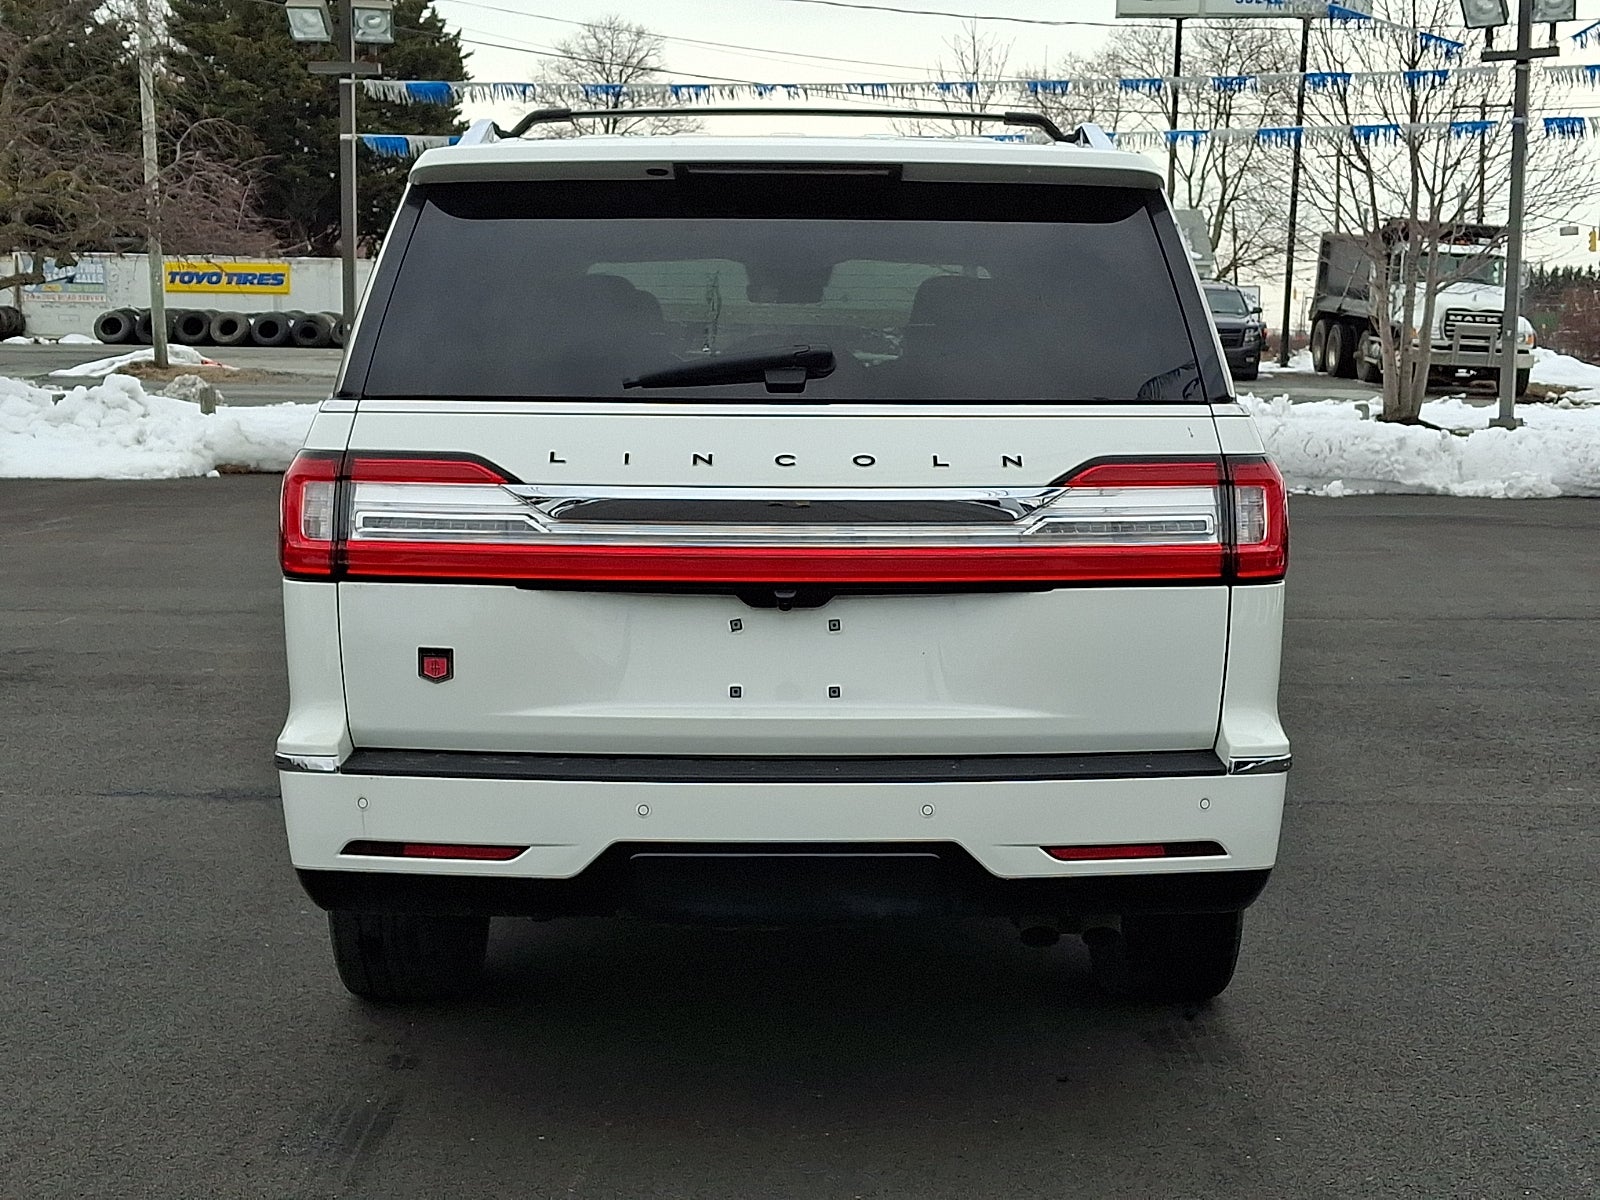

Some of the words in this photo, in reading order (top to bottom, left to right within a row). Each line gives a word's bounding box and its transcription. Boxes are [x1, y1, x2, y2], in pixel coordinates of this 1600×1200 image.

[74, 274, 104, 283] SALES
[168, 271, 222, 285] TOYO
[225, 272, 285, 286] TIRES
[1449, 315, 1501, 323] MACK
[549, 451, 1023, 468] LINCOLN
